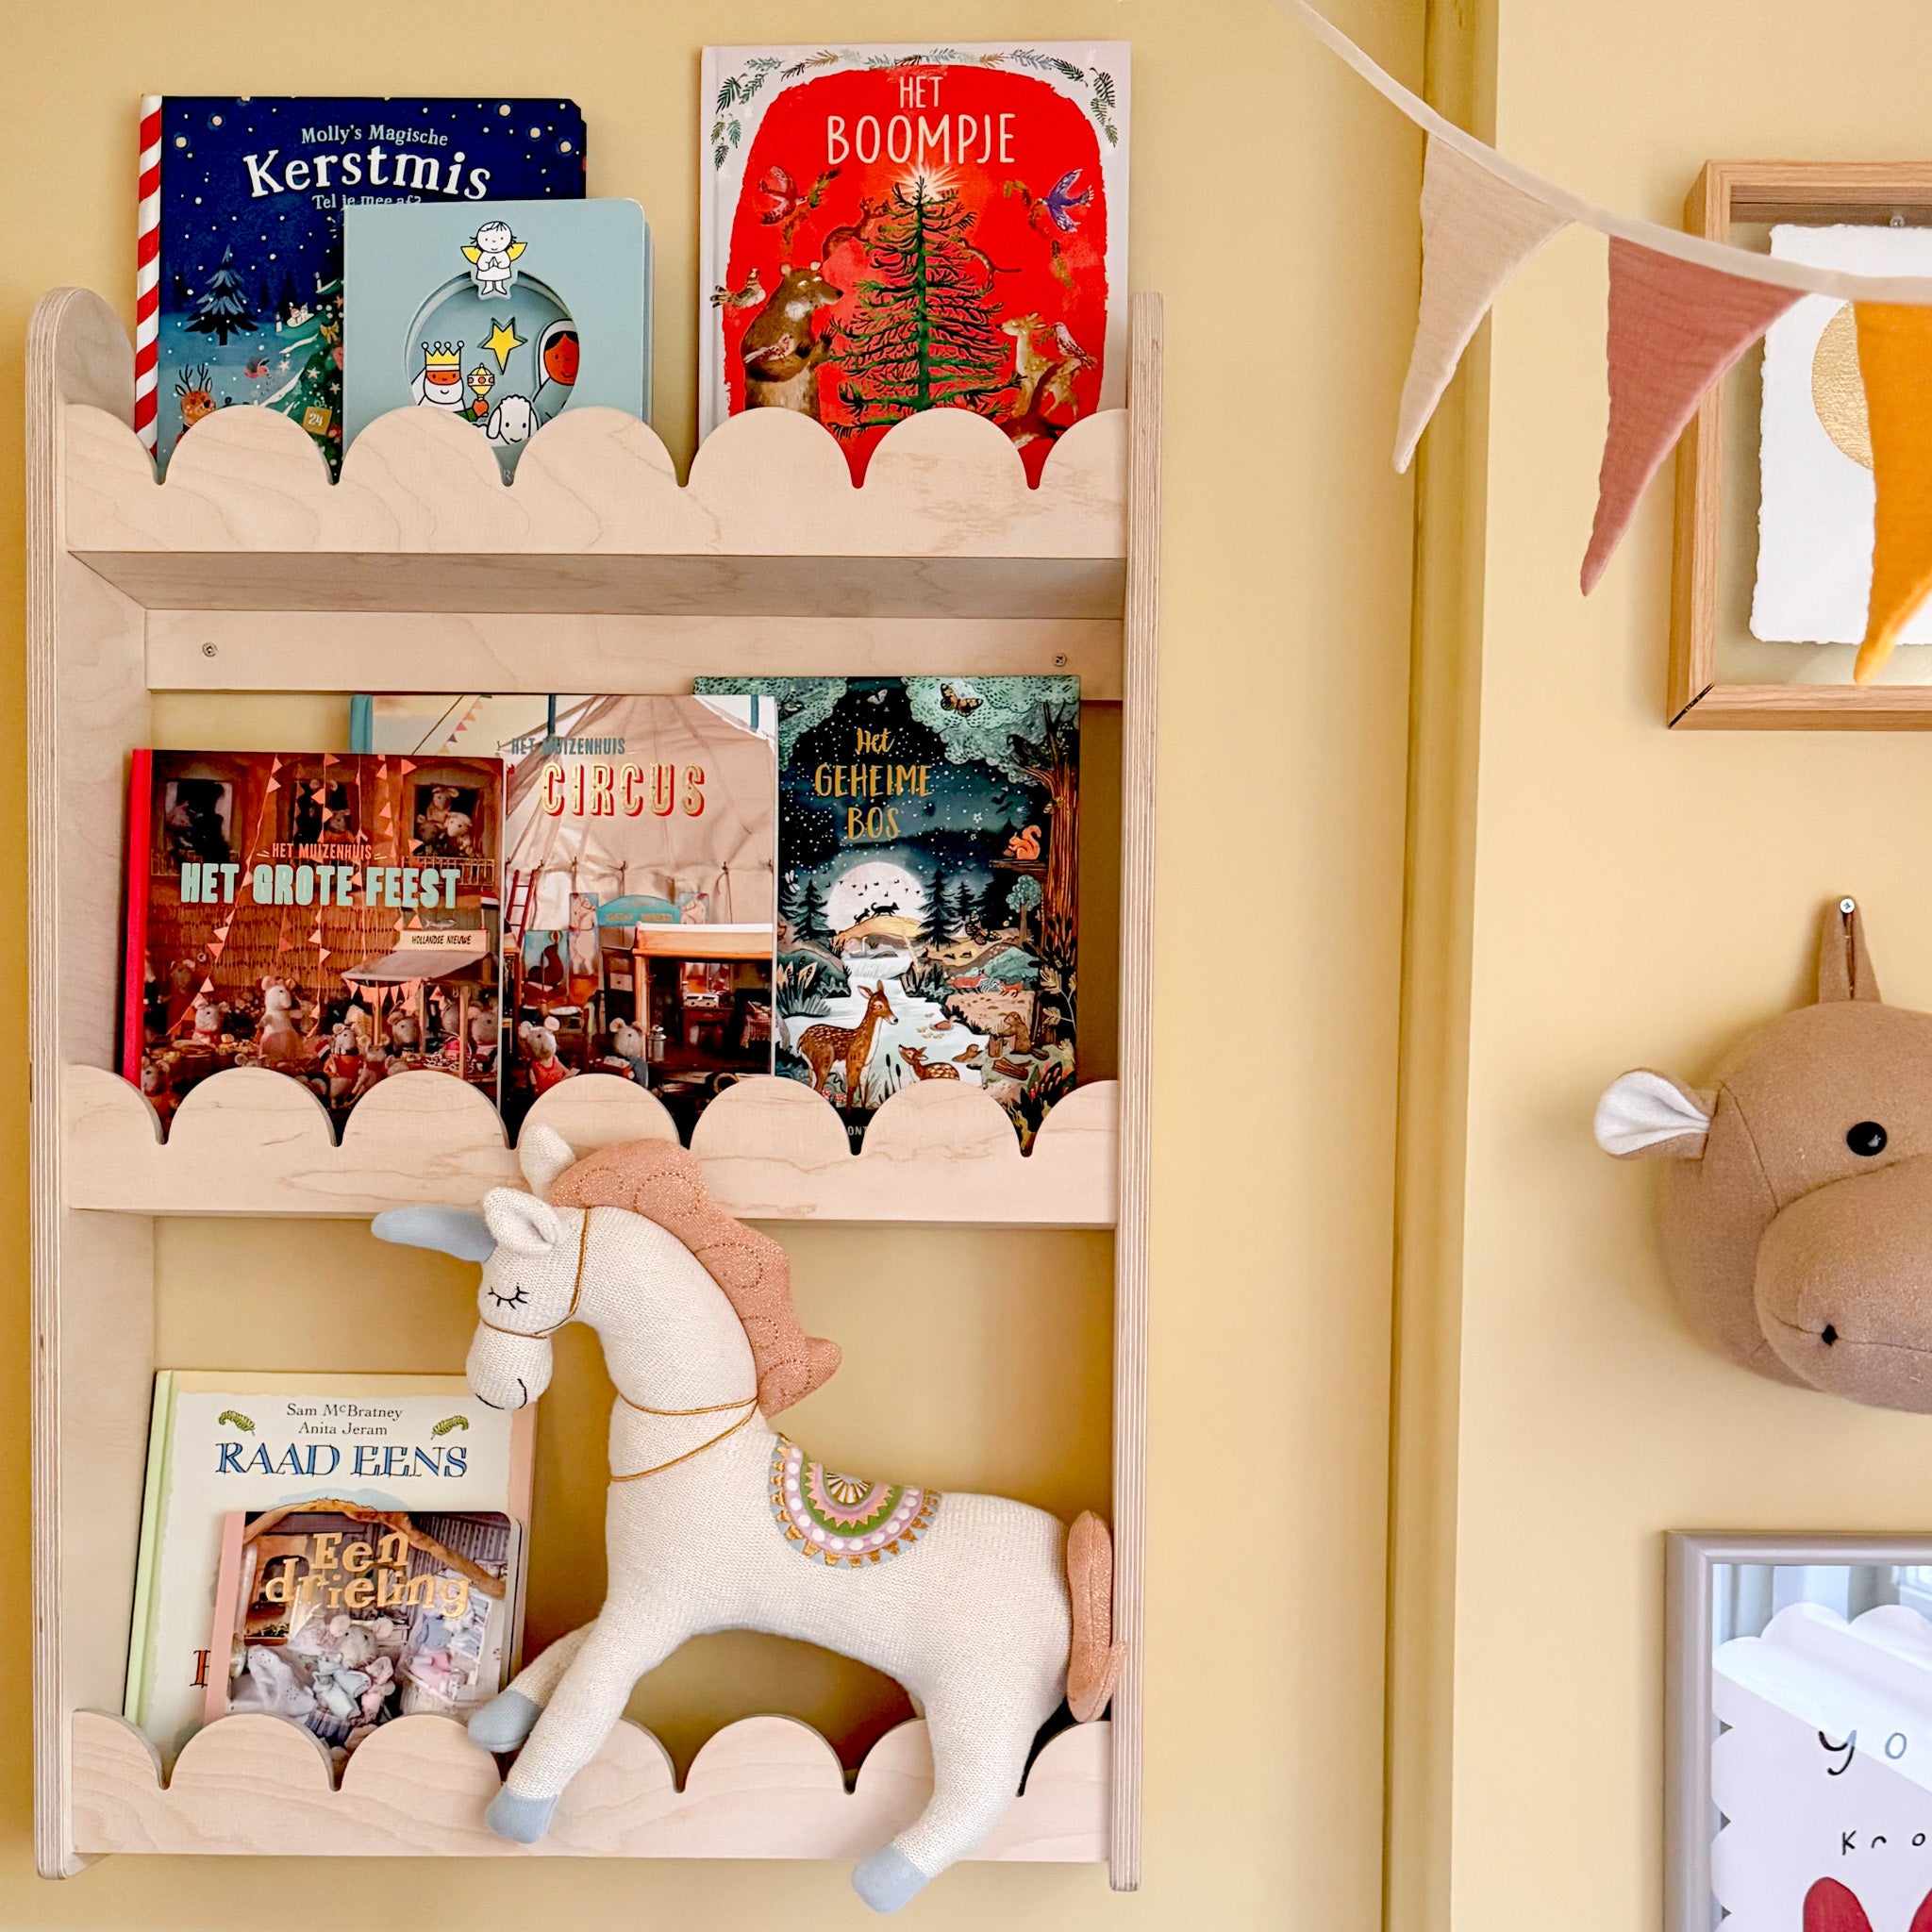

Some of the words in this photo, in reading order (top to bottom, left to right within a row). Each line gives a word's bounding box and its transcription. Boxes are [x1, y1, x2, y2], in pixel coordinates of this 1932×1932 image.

[899, 75, 944, 109] HET
[301, 125, 362, 145] Molly's
[368, 125, 448, 146] Magische
[826, 113, 1016, 165] BOOMPJE
[242, 145, 491, 200] Kerstmis
[311, 193, 337, 209] Tel
[308, 413, 323, 425] 24
[511, 738, 535, 755] HET
[856, 727, 895, 755] Het
[541, 762, 705, 817] CIRCUS
[815, 763, 933, 798] GEHEIME
[847, 807, 901, 841] BOS
[272, 842, 293, 858] HET
[299, 842, 372, 860] MUIZENHUIS
[180, 863, 240, 904] HET
[253, 864, 354, 907] GROTE
[366, 867, 461, 909] FEEST
[411, 935, 444, 945] HOLLANDSE
[447, 935, 472, 945] NIEUWE
[287, 1403, 317, 1416] Sam
[323, 1404, 403, 1422] McBratney
[298, 1422, 337, 1435] Anita
[341, 1423, 388, 1436] Jeram
[215, 1441, 341, 1478] RAAD
[351, 1444, 468, 1479] EENS
[311, 1530, 410, 1572] Een
[265, 1557, 470, 1619] drieling
